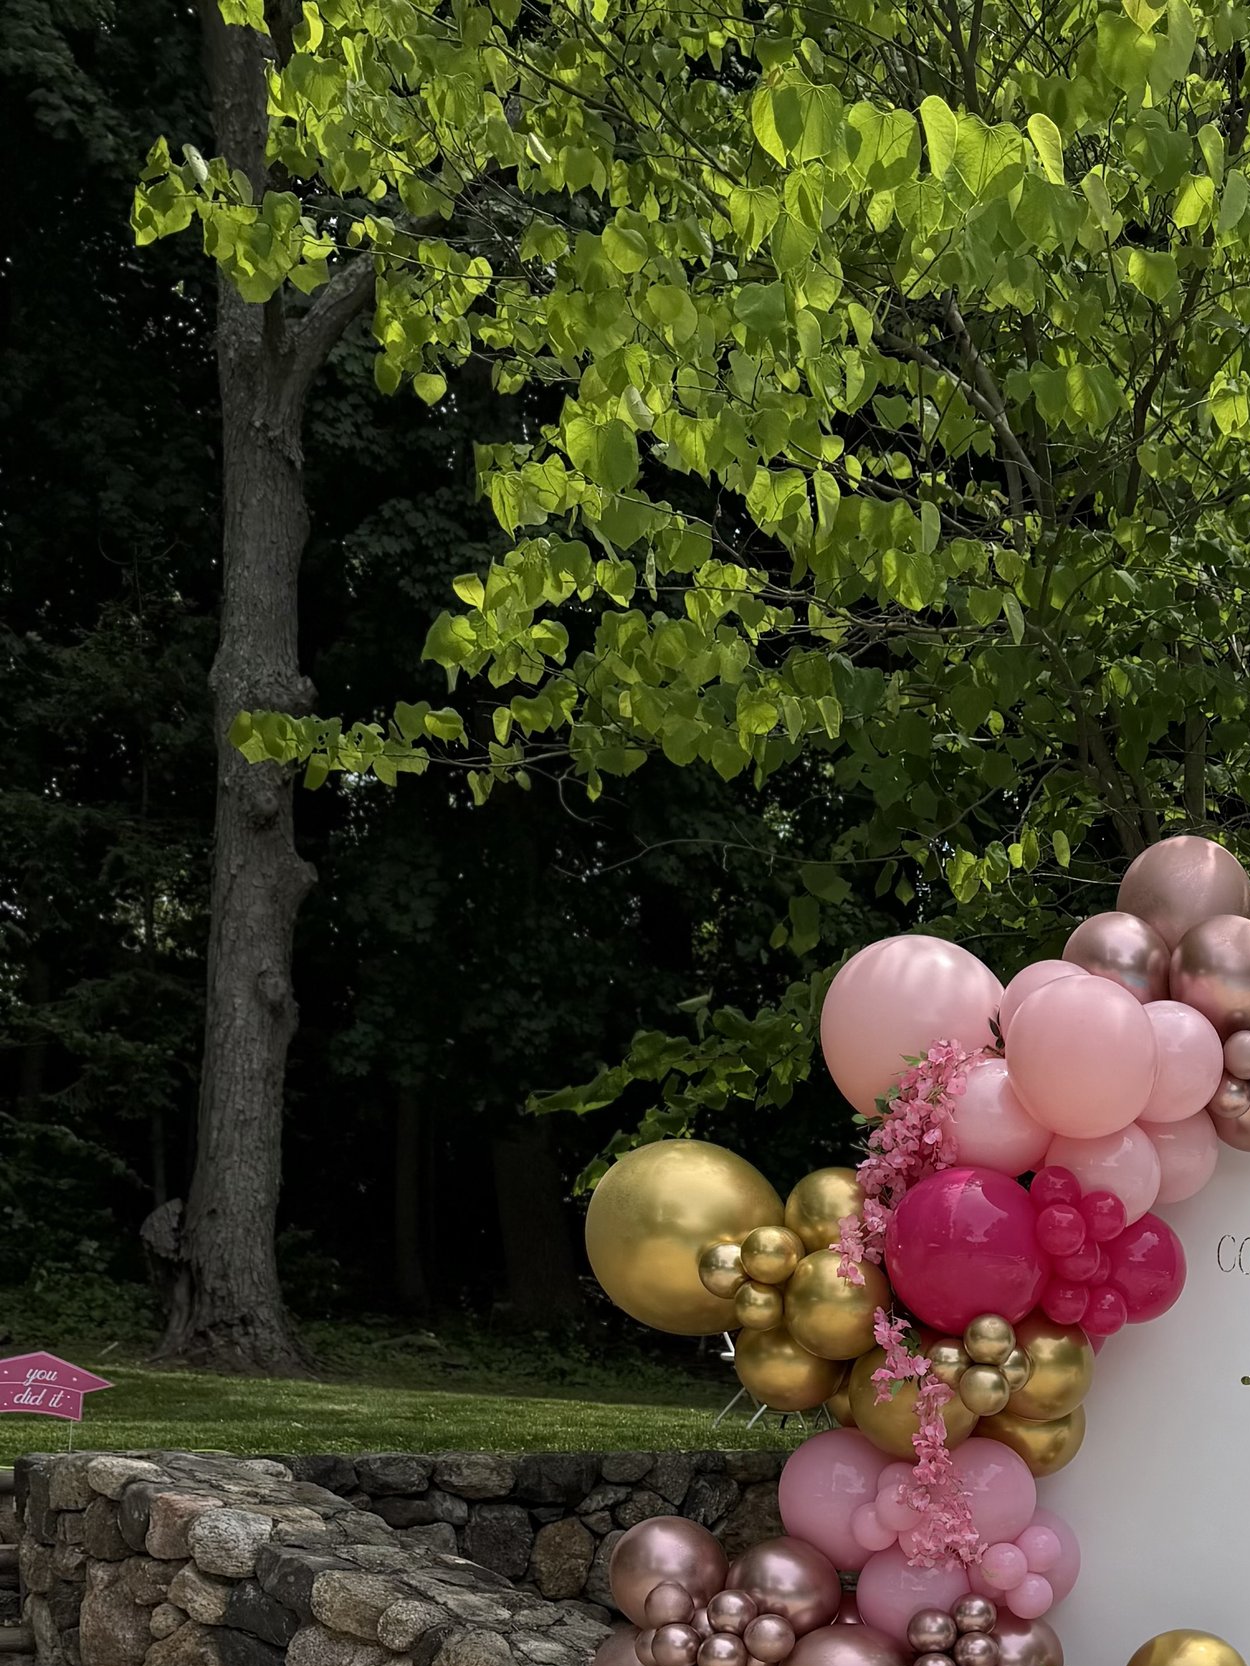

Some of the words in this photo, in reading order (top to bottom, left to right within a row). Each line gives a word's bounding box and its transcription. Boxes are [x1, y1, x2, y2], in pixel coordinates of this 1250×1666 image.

[23, 1368, 58, 1387] you
[13, 1387, 47, 1406] did
[48, 1390, 64, 1408] it
